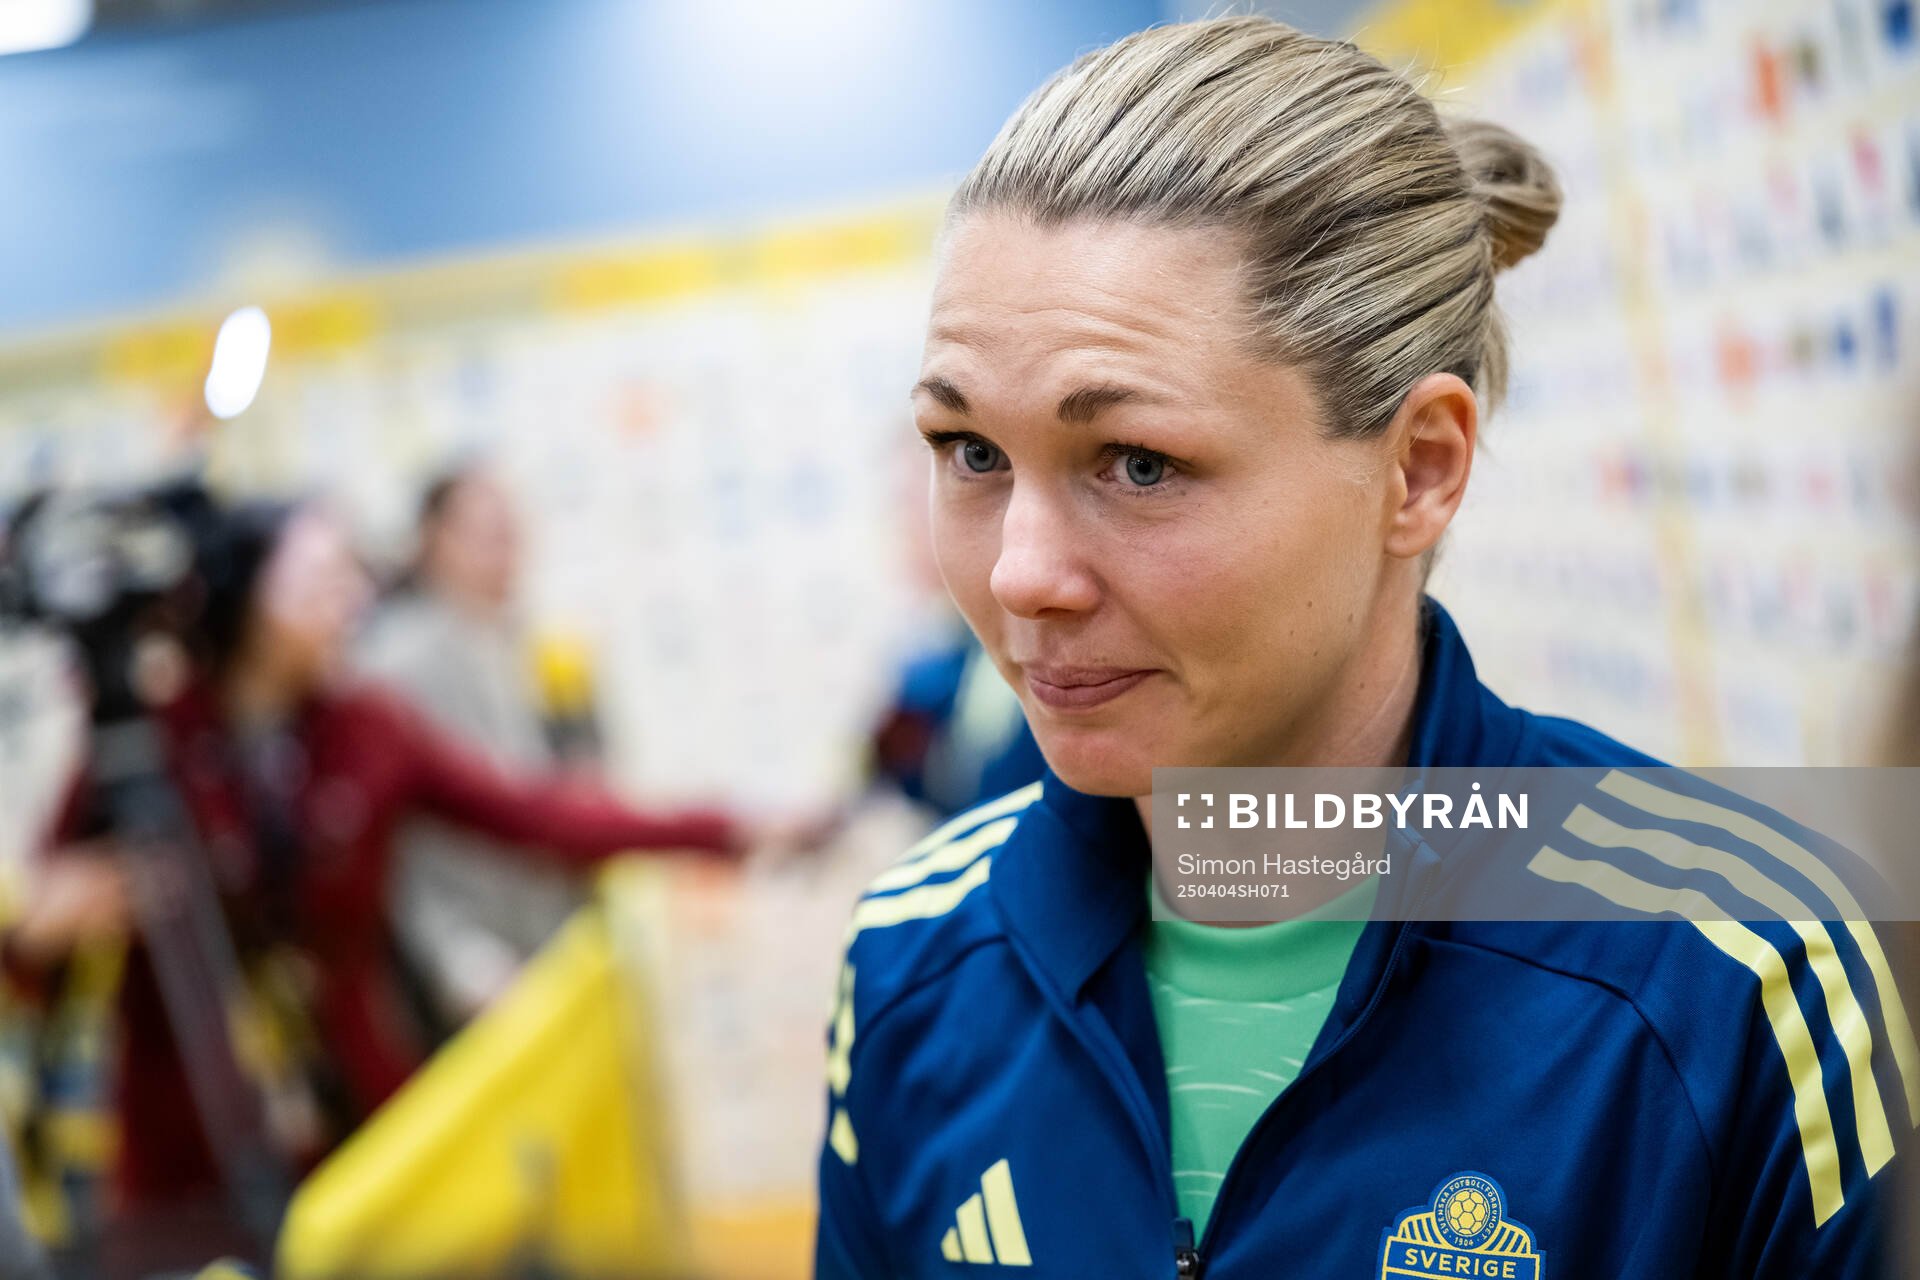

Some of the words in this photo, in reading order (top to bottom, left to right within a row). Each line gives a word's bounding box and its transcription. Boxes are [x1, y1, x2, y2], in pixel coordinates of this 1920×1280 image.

[1437, 1191, 1450, 1235] SVENSKA
[1449, 1179, 1498, 1240] FOTBOLLFÖRBUNDET
[1454, 1237, 1474, 1246] 1904
[1405, 1248, 1517, 1278] SVERIGE
